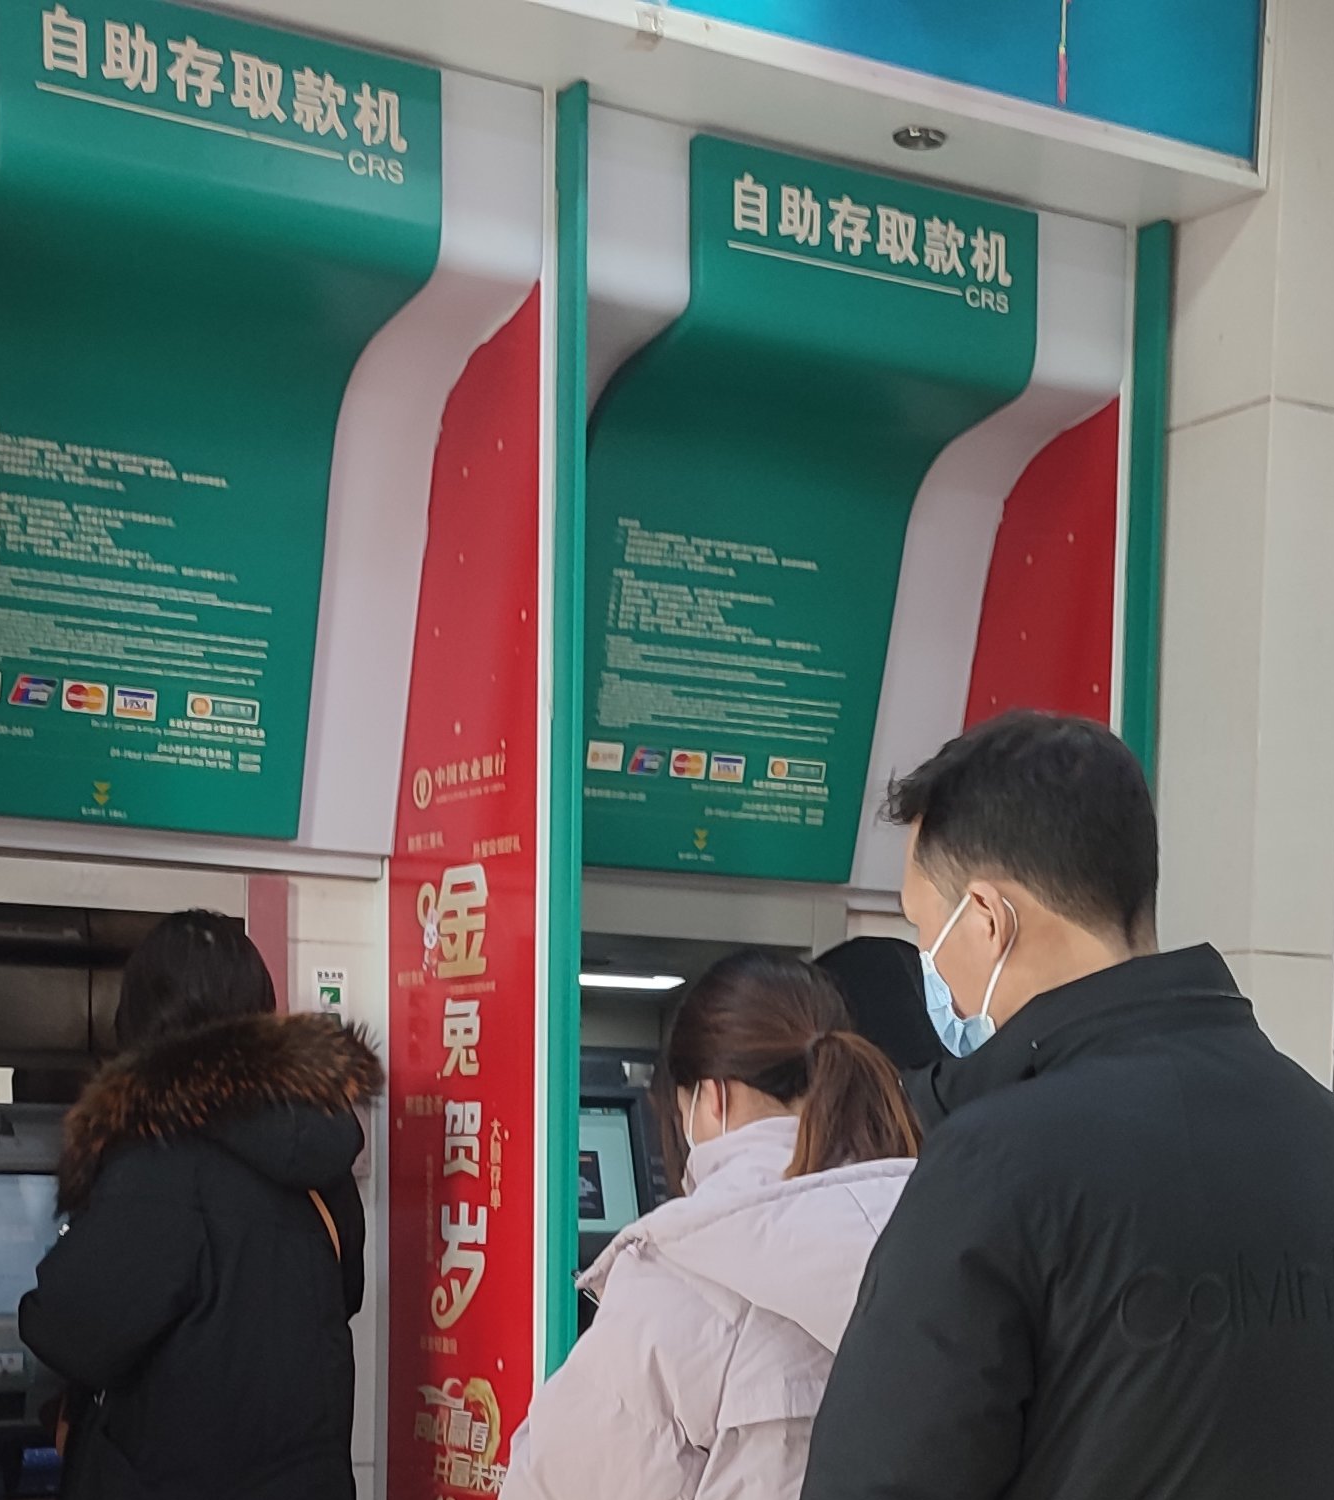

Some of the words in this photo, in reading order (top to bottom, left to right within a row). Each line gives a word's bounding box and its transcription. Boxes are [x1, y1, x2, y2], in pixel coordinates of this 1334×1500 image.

[41, 4, 408, 155] 自助存取款机
[348, 149, 405, 185] CRS
[733, 173, 1013, 287] 自助存取款机
[965, 284, 1010, 314] CRS
[122, 697, 149, 711] VISA
[434, 752, 506, 790] 中国农业银行
